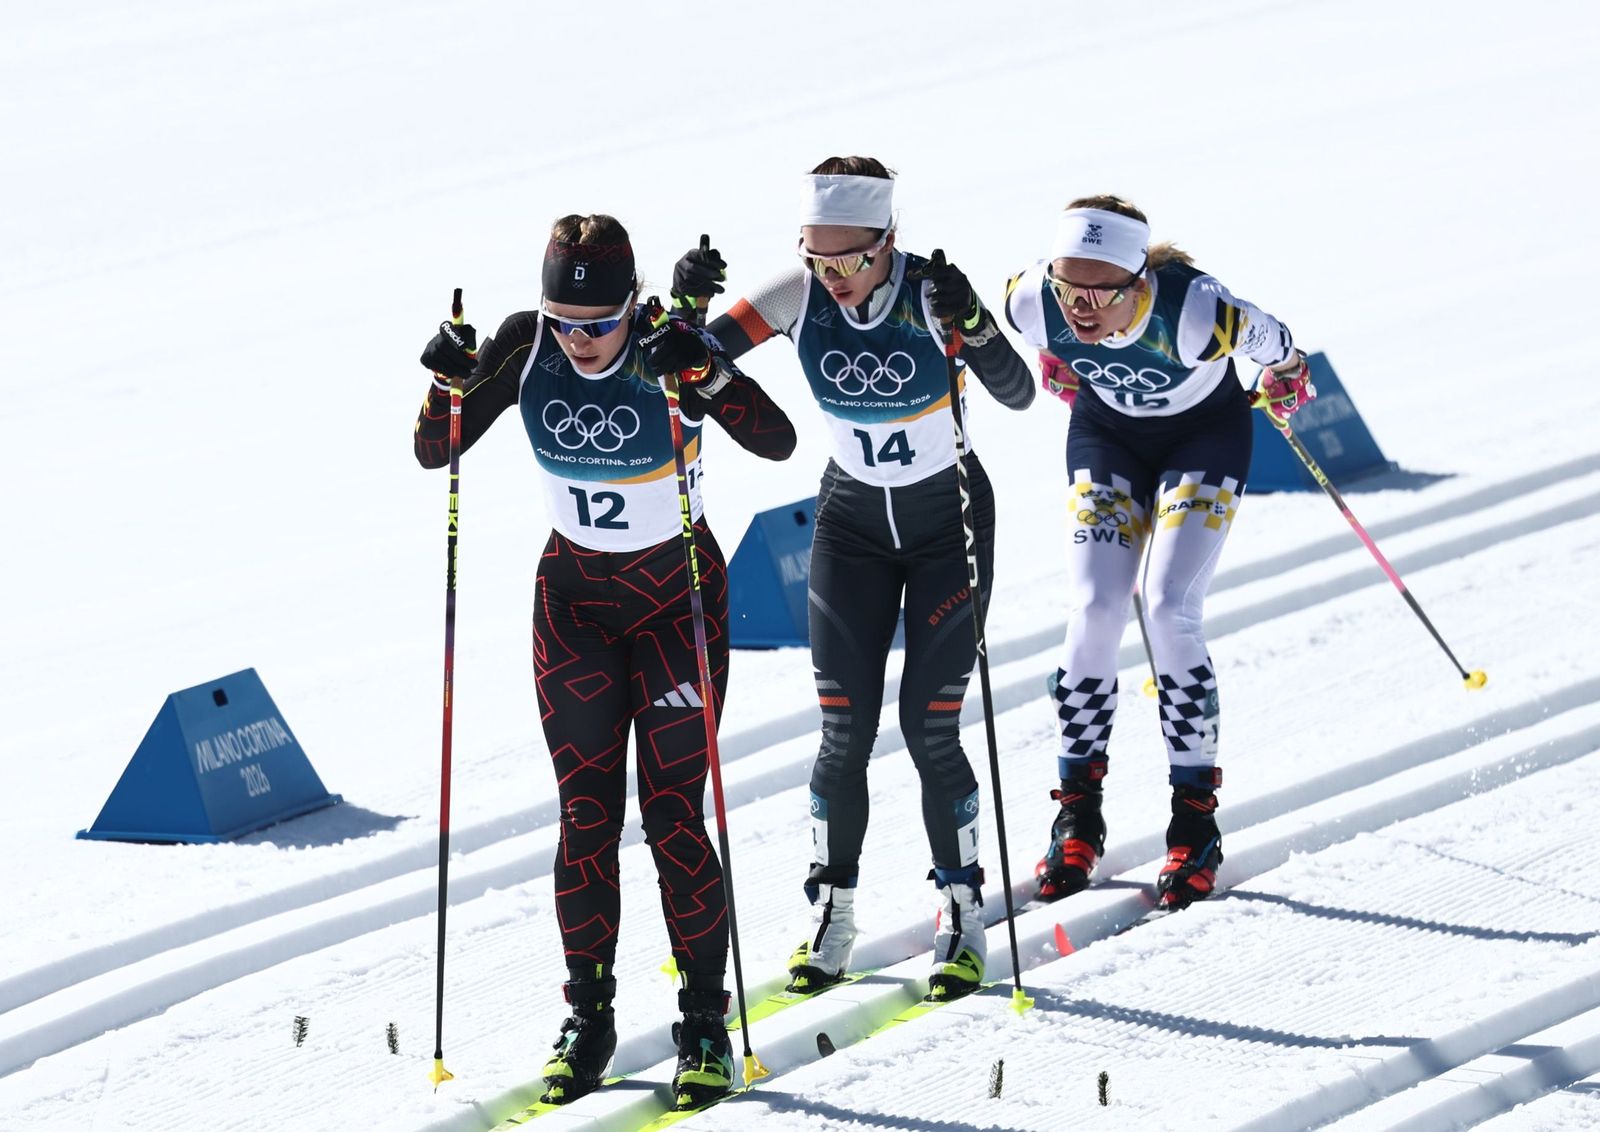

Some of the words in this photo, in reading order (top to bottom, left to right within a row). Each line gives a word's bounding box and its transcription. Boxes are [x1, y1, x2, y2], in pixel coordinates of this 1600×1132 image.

[1082, 237, 1102, 245] SWE
[822, 396, 860, 407] MILANO
[862, 400, 908, 408] CORTINA
[910, 394, 931, 406] 2026
[536, 448, 576, 463] MILANO
[578, 456, 627, 466] CORTINA
[629, 456, 653, 466] 2026
[853, 428, 916, 467] 14
[448, 474, 460, 537] LEKI
[568, 486, 629, 529] 12
[676, 475, 692, 537] LEKI
[1158, 500, 1212, 518] CRAFT
[1073, 528, 1131, 549] SWE
[689, 544, 700, 591] LEKI
[196, 731, 243, 774] MILANO
[237, 717, 292, 757] CORTINA
[240, 763, 271, 797] 2026
